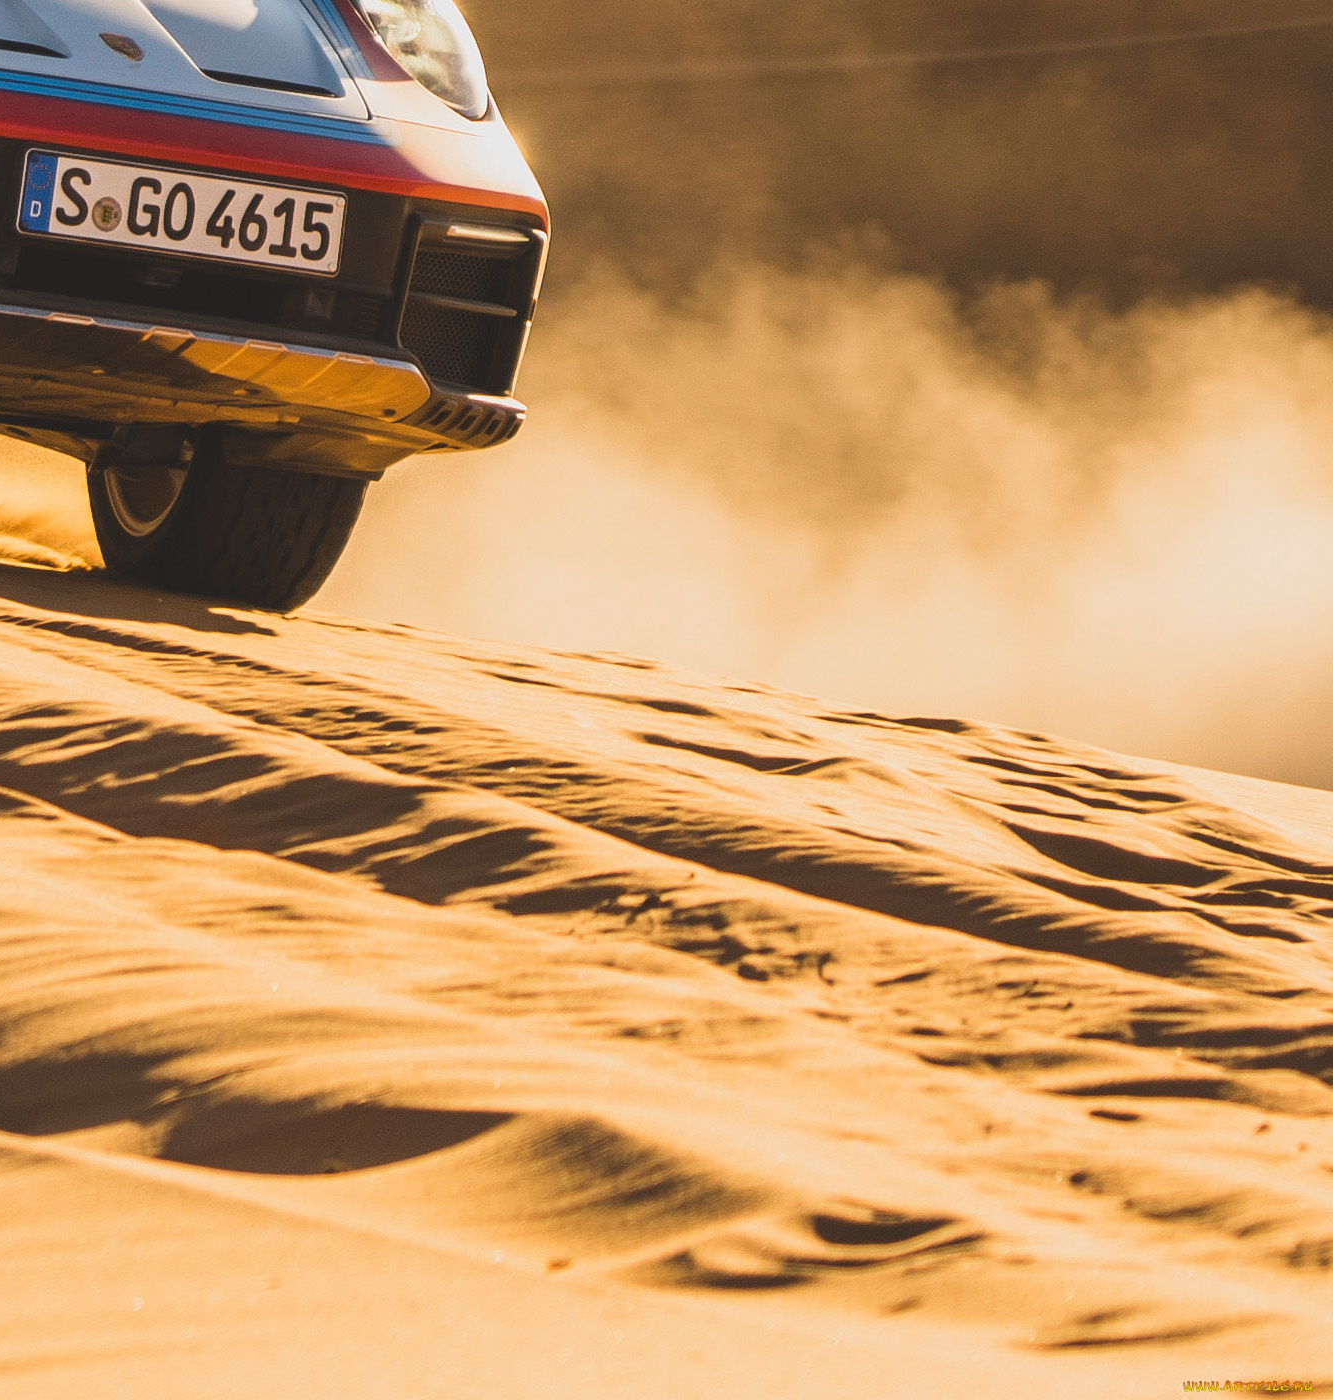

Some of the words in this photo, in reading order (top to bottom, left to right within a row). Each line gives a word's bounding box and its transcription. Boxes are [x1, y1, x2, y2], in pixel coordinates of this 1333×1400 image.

[29, 200, 42, 218] D
[55, 167, 92, 227] S
[126, 176, 196, 242] GO
[205, 189, 334, 262] 4615
